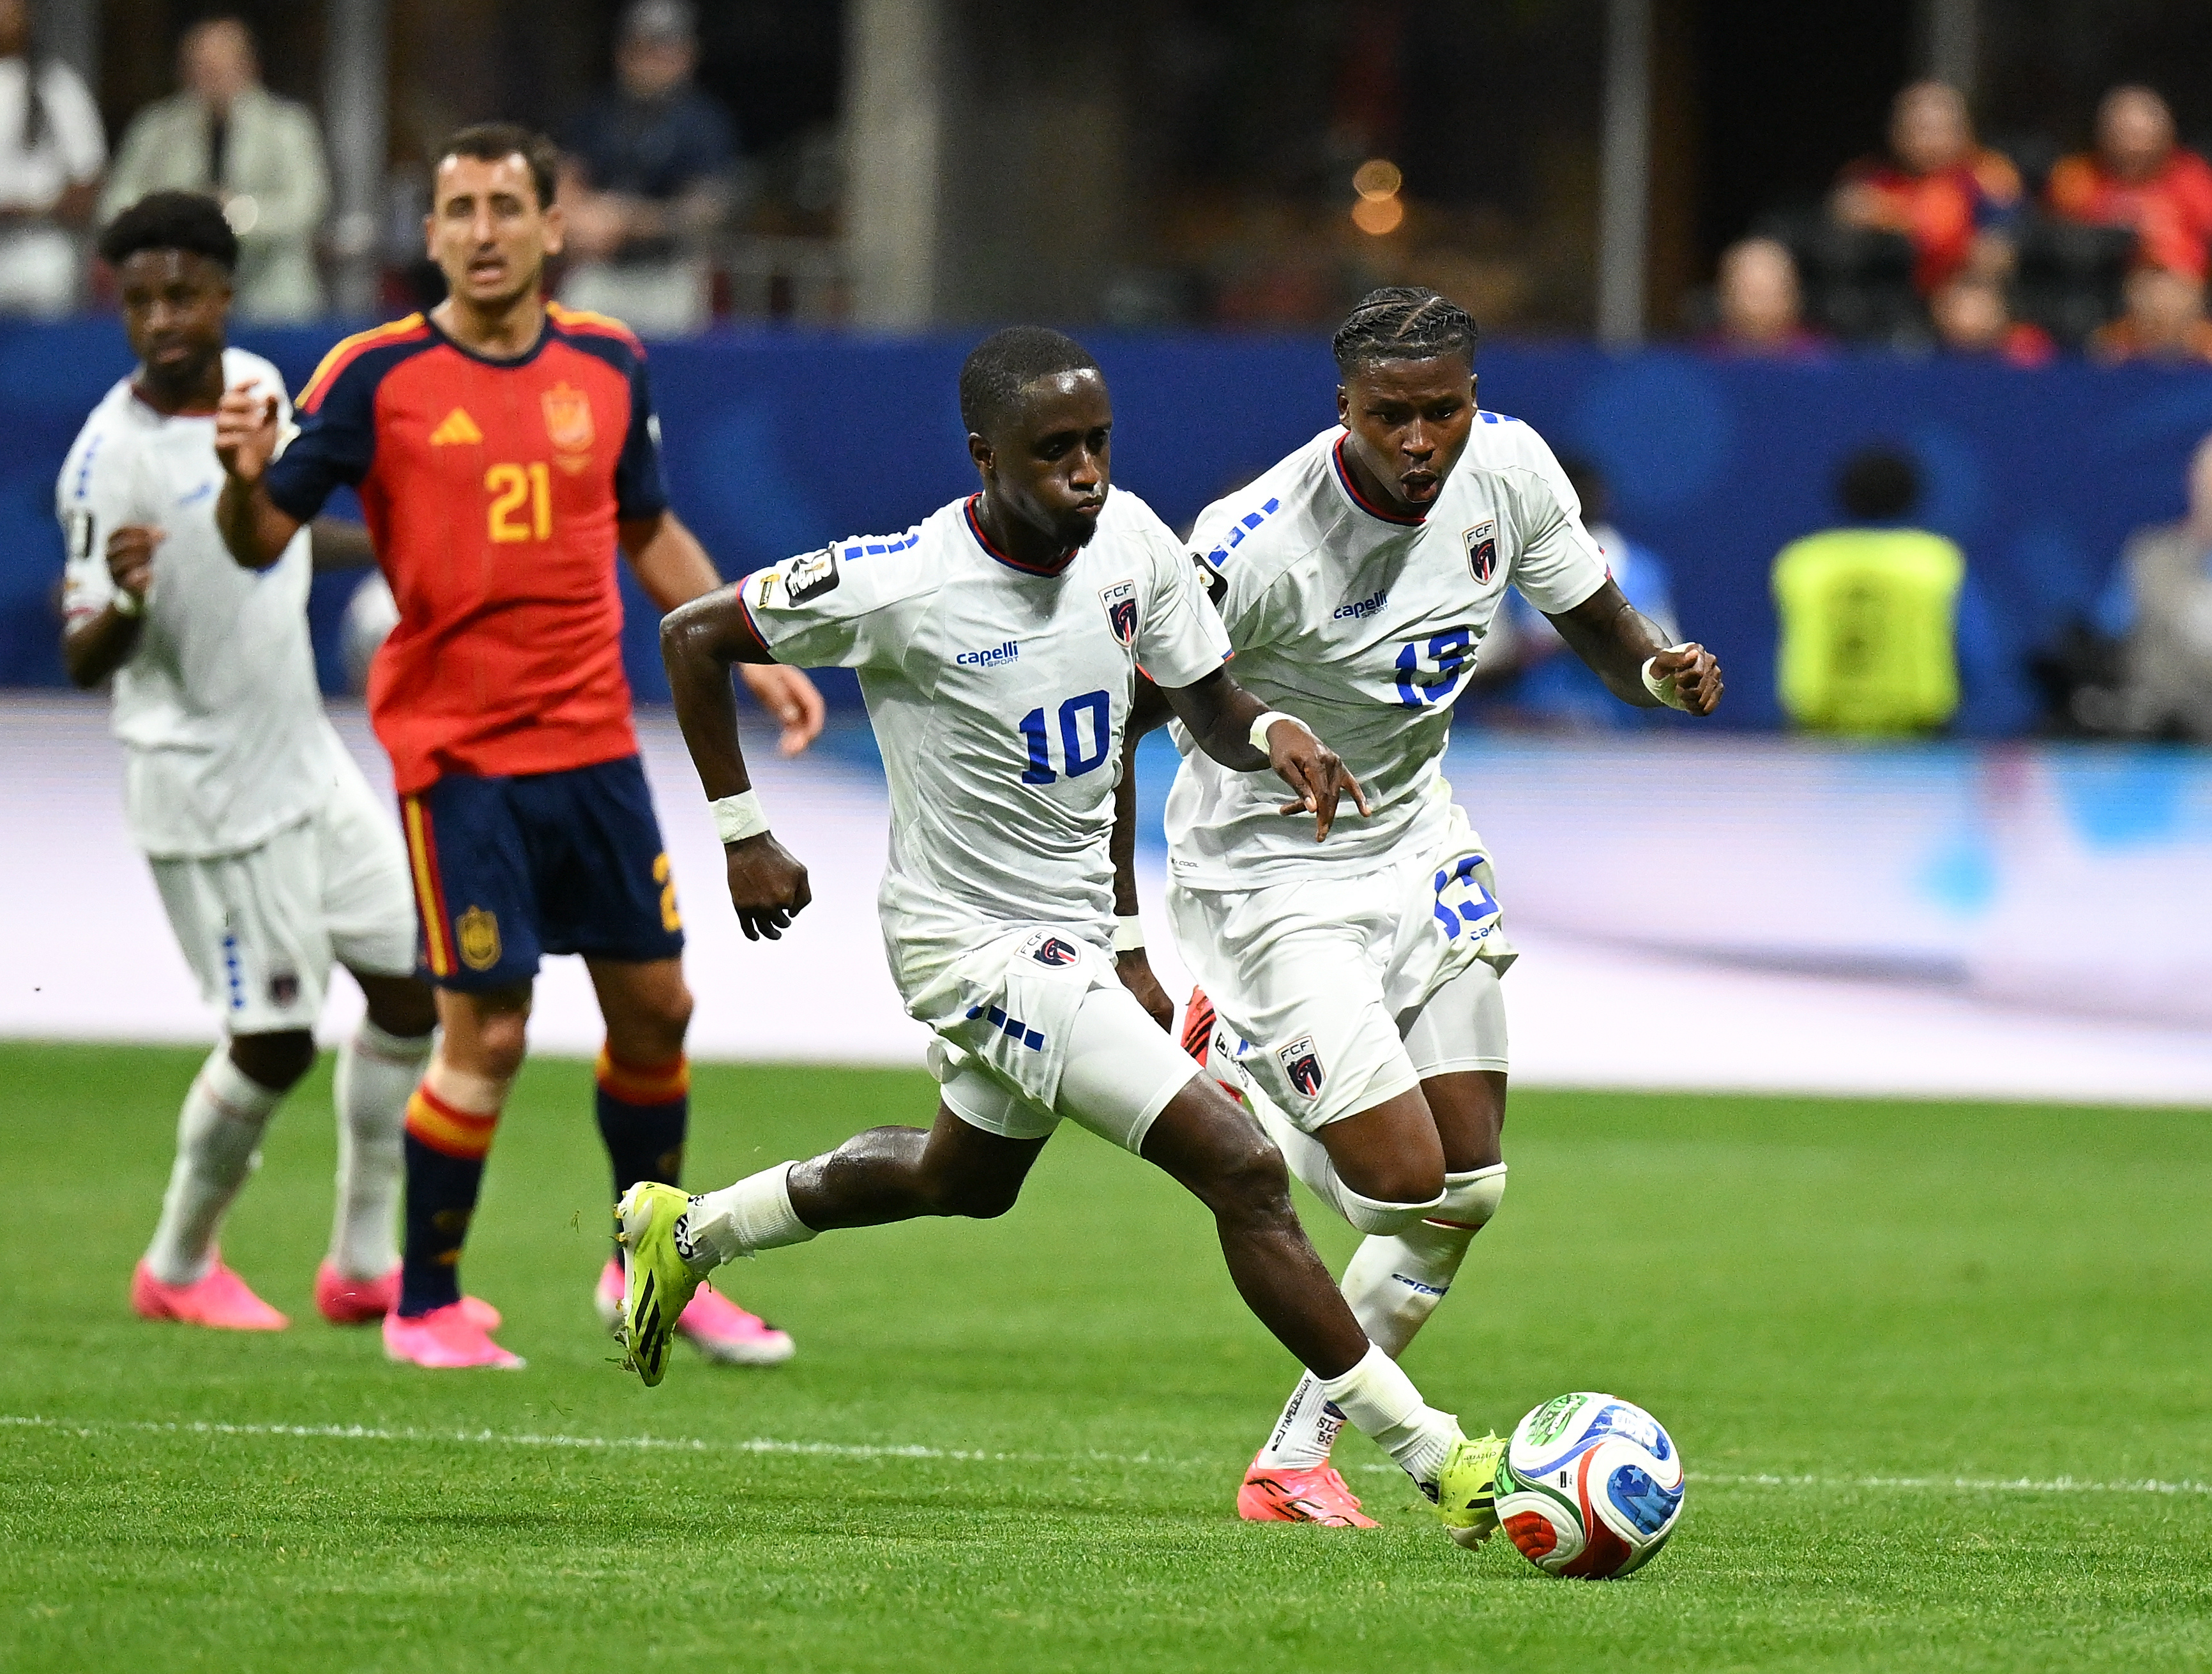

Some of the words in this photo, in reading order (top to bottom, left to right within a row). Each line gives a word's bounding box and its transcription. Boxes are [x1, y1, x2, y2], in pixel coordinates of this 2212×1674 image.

[484, 462, 552, 542] 21
[1467, 524, 1492, 543] FCF
[1103, 583, 1132, 602] FCF
[1333, 588, 1388, 620] capelli
[956, 640, 1019, 667] capelli
[987, 655, 1019, 667] SPORT
[1395, 625, 1469, 710] 13
[1019, 689, 1110, 785] 10
[1020, 932, 1043, 955] FCF
[1280, 1040, 1310, 1061] FCF
